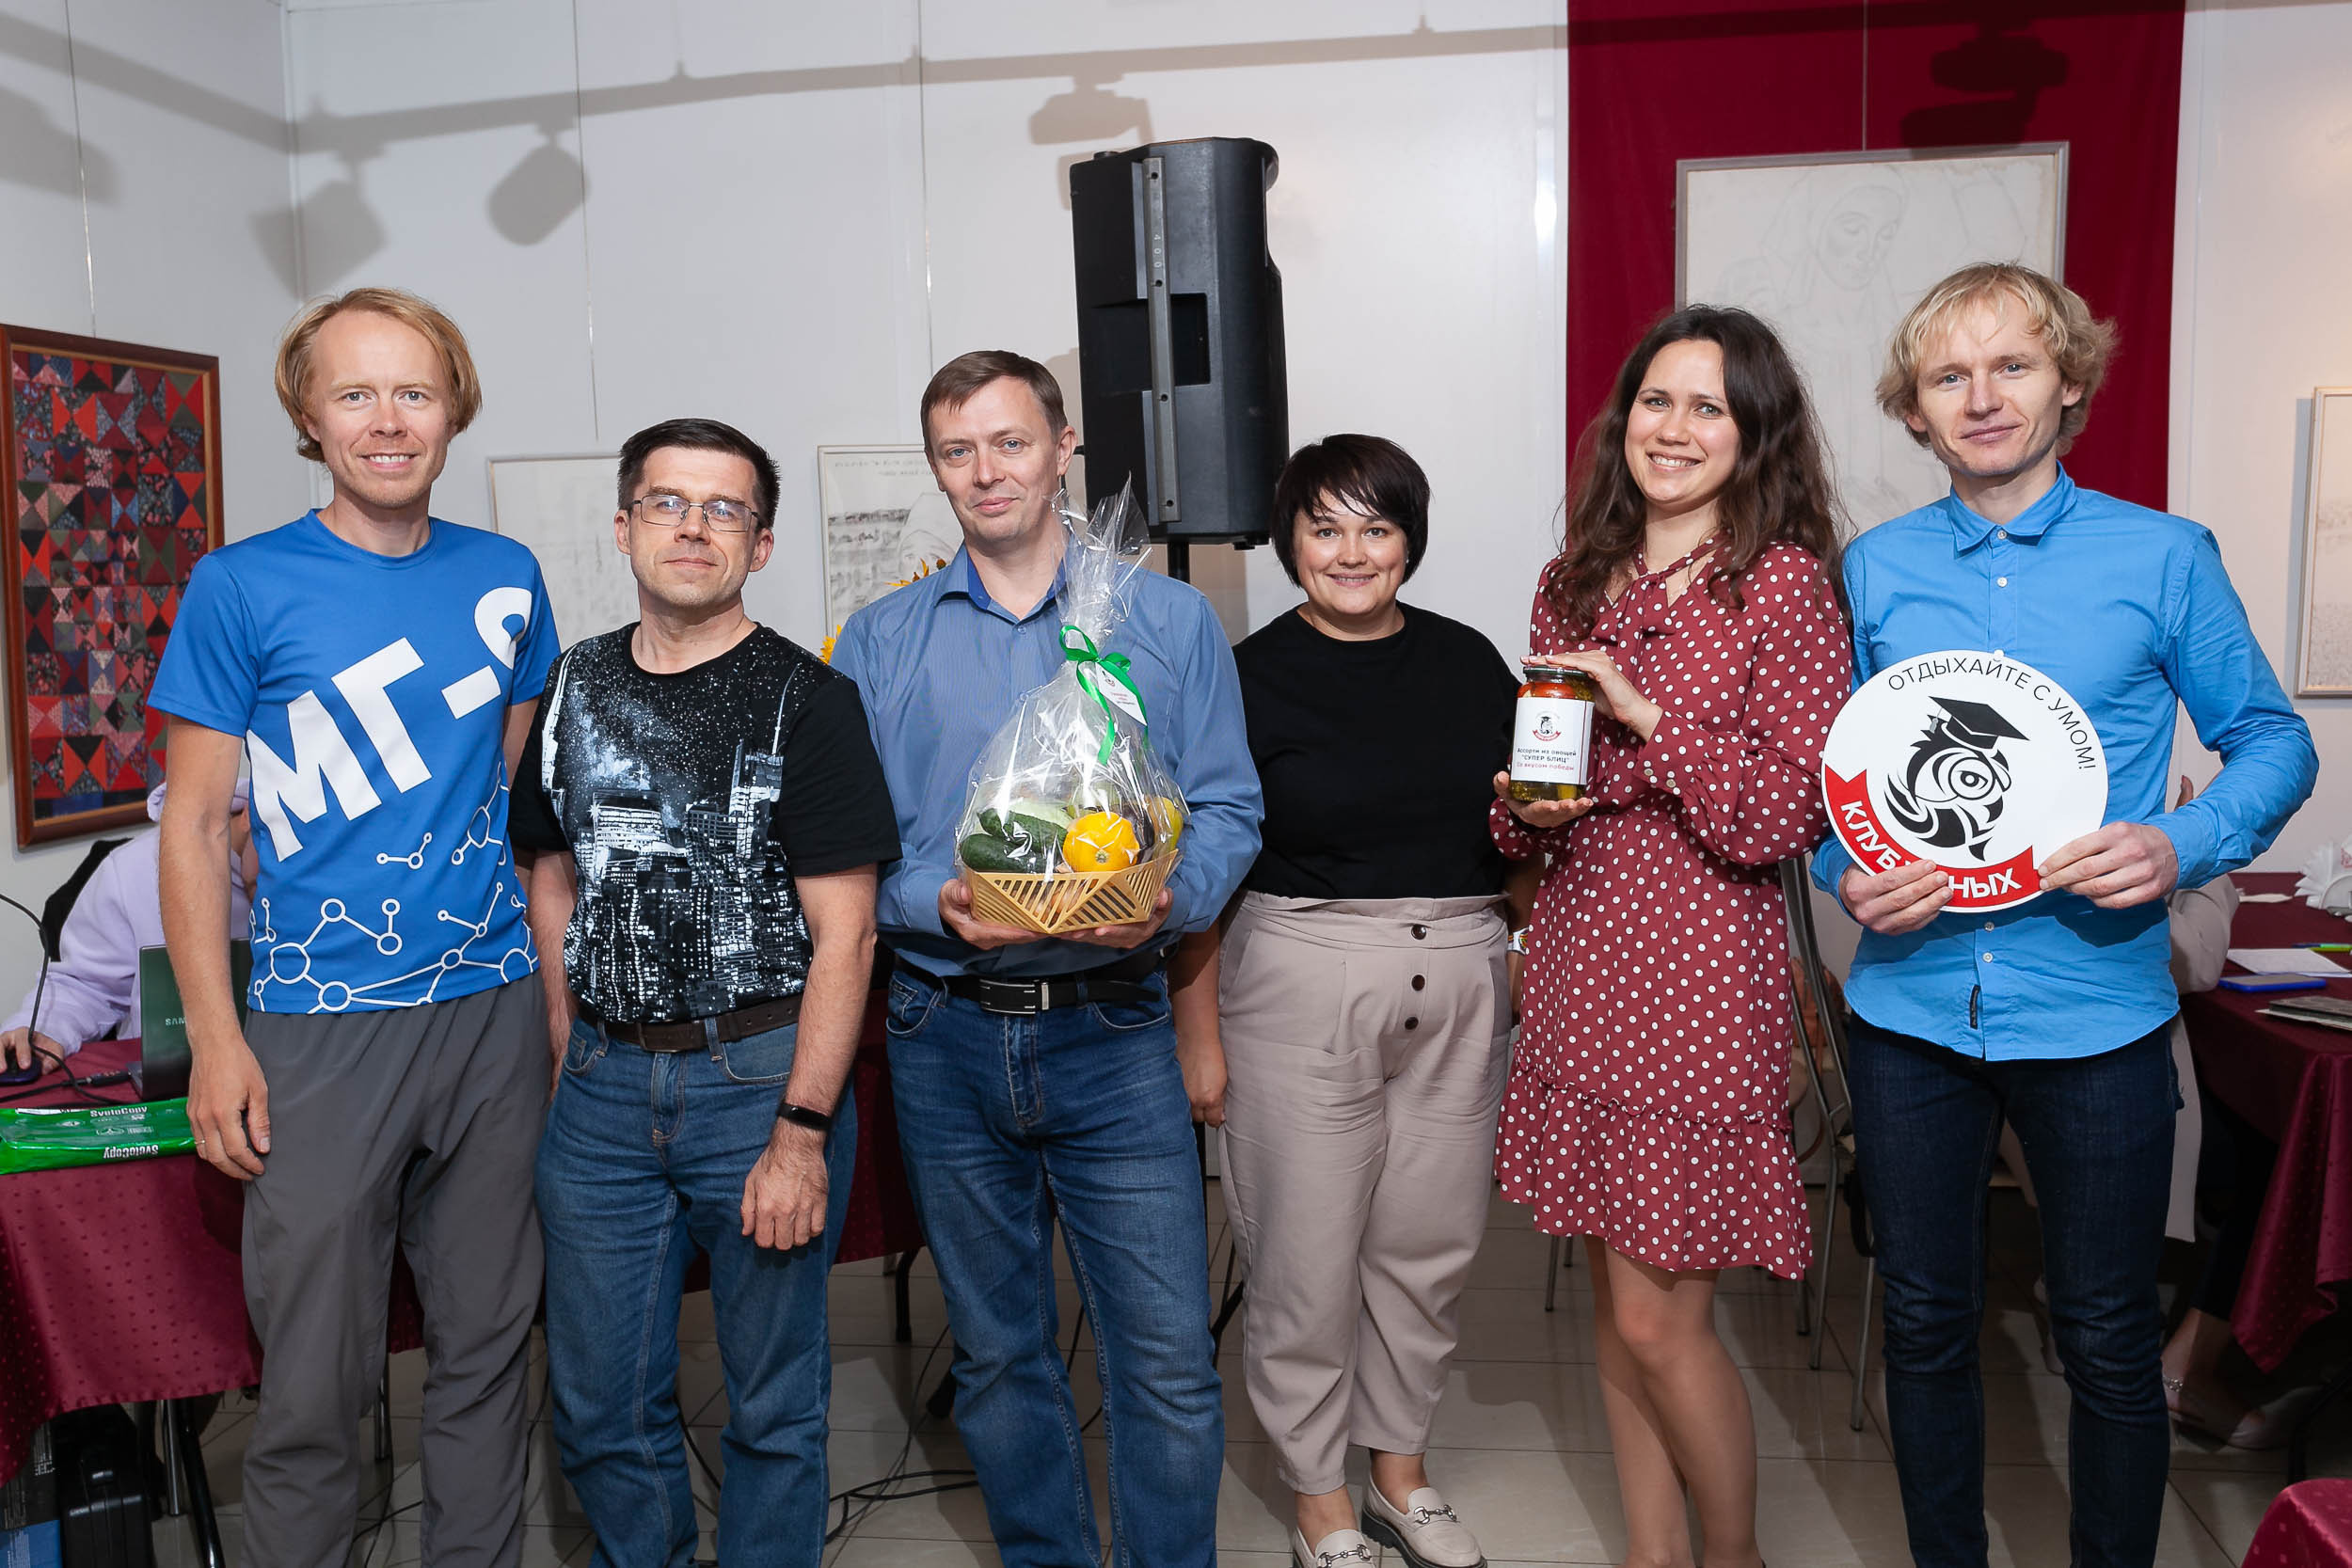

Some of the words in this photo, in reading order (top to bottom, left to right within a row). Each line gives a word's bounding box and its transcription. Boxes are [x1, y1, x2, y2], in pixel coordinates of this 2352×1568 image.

[1888, 657, 2032, 691] ОТДЫХАЙТЕ
[2033, 684, 2051, 701] С
[2048, 698, 2096, 770] УМОМ!
[1840, 800, 1902, 870] КЛУБ
[1947, 867, 2023, 899] НЫХ
[103, 1144, 159, 1159] SvetoCopy
